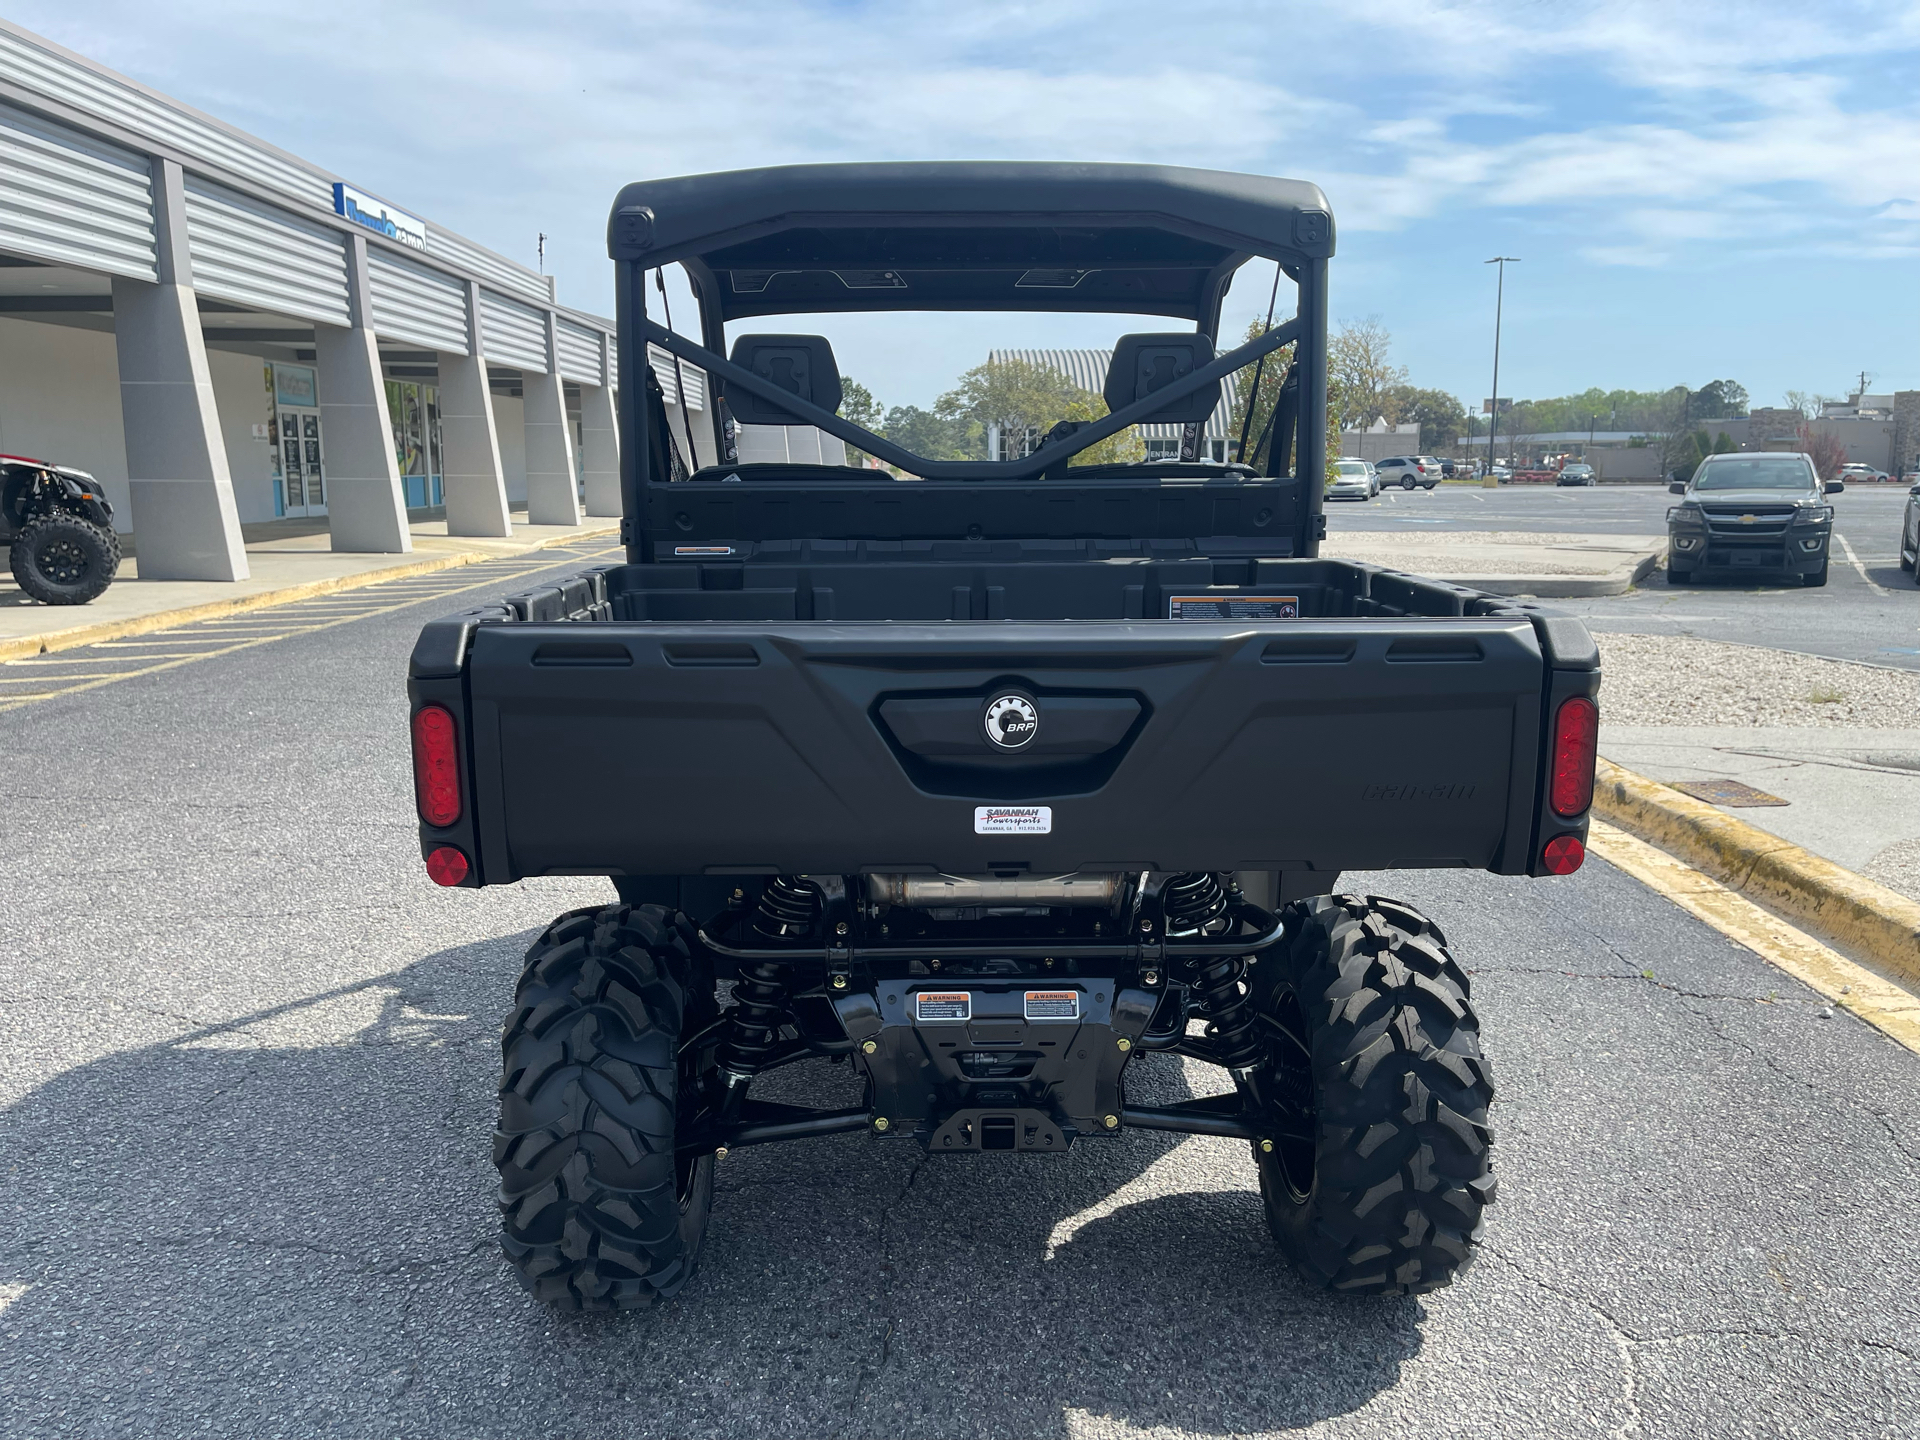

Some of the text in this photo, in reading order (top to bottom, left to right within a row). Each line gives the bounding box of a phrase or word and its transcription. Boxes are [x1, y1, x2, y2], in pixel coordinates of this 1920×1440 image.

[1150, 450, 1179, 458] ENTRAN
[1007, 723, 1035, 732] BRP
[986, 808, 1039, 816] SAVANNAH
[986, 814, 1041, 826] Powersports
